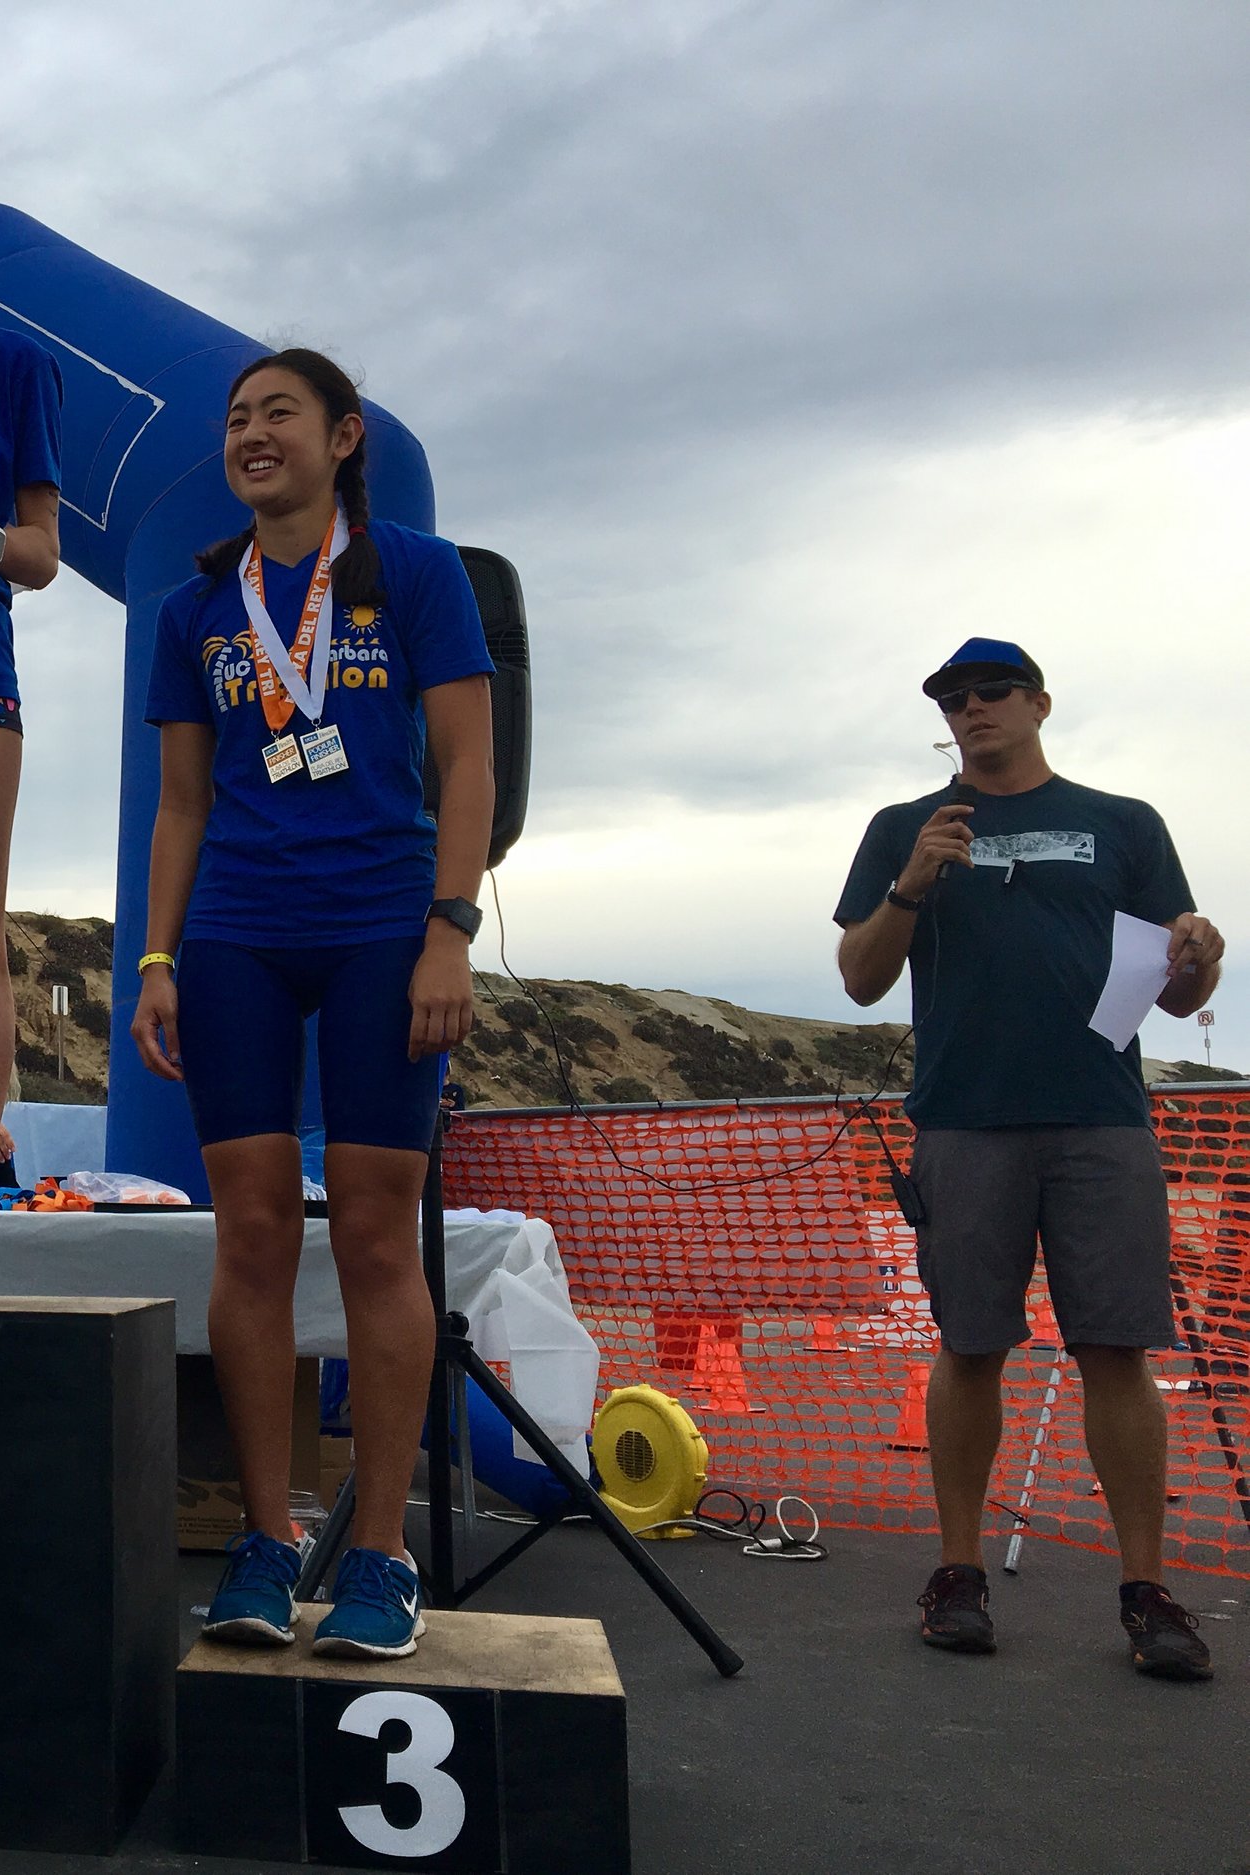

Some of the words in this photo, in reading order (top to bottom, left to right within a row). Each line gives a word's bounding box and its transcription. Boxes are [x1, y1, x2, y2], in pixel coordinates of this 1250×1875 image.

[306, 583, 325, 613] REY
[298, 617, 317, 646] DEL
[224, 660, 251, 680] UC
[259, 667, 276, 697] TRI
[269, 747, 295, 765] FINISHER
[308, 738, 337, 756] PODIUM
[310, 744, 340, 762] FINISHER
[312, 762, 346, 777] TRIATHLON
[336, 1690, 466, 1858] 3
